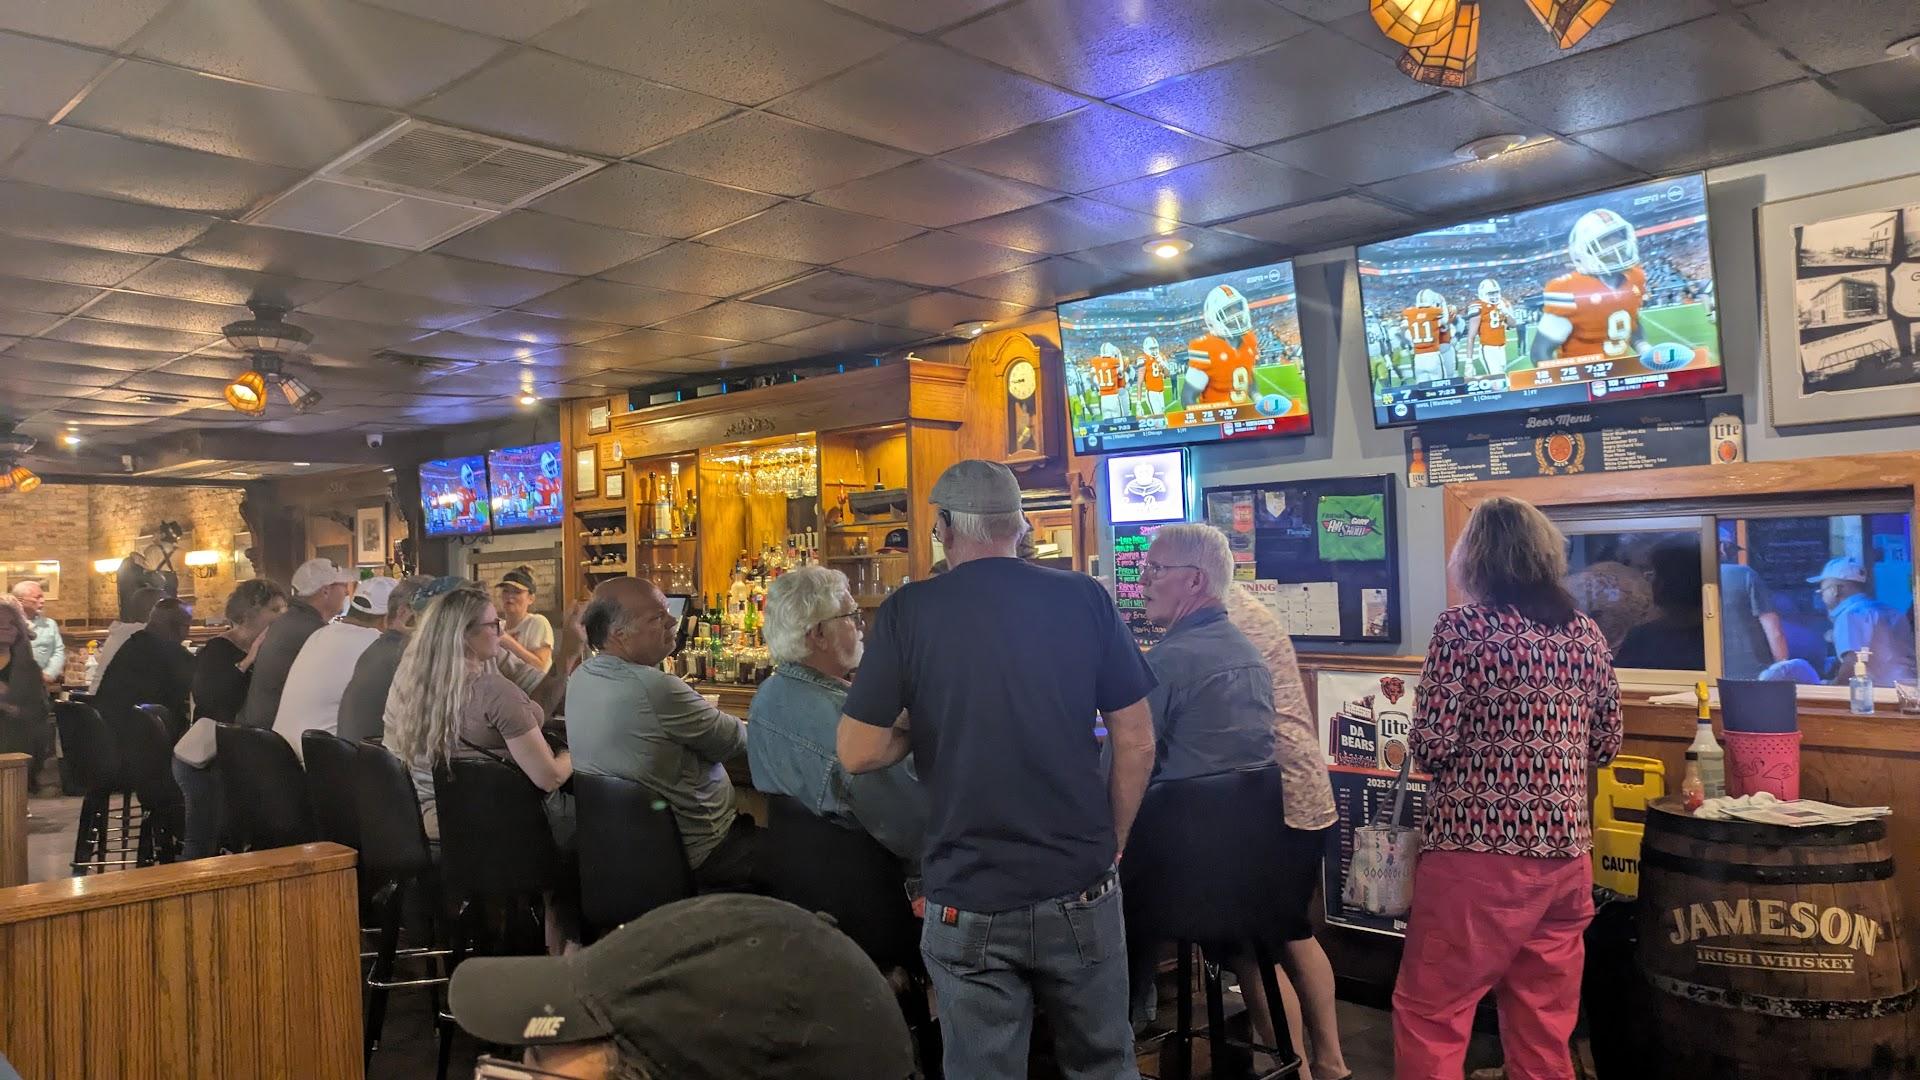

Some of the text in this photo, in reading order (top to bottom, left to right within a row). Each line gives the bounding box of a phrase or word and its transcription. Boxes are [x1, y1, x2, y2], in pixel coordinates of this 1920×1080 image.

[1411, 320, 1434, 344] 11
[1603, 310, 1632, 356] 9
[1584, 361, 1614, 374] 7:37
[1098, 368, 1115, 387] 11
[1229, 366, 1250, 403] 9
[1467, 379, 1491, 392] 20
[1399, 389, 1412, 400] 7
[1526, 413, 1592, 429] Beer Menu
[1714, 423, 1739, 440] Lite
[1350, 724, 1365, 738] DA
[1381, 718, 1408, 739] Lite
[1341, 734, 1375, 752] BEARS
[1366, 777, 1427, 793] 2025 SDULE
[1602, 854, 1639, 875] CAUTI
[1669, 898, 1878, 957] JAMESON
[1697, 949, 1854, 970] IRISH WHISKEY
[523, 1016, 565, 1039] NIKE
